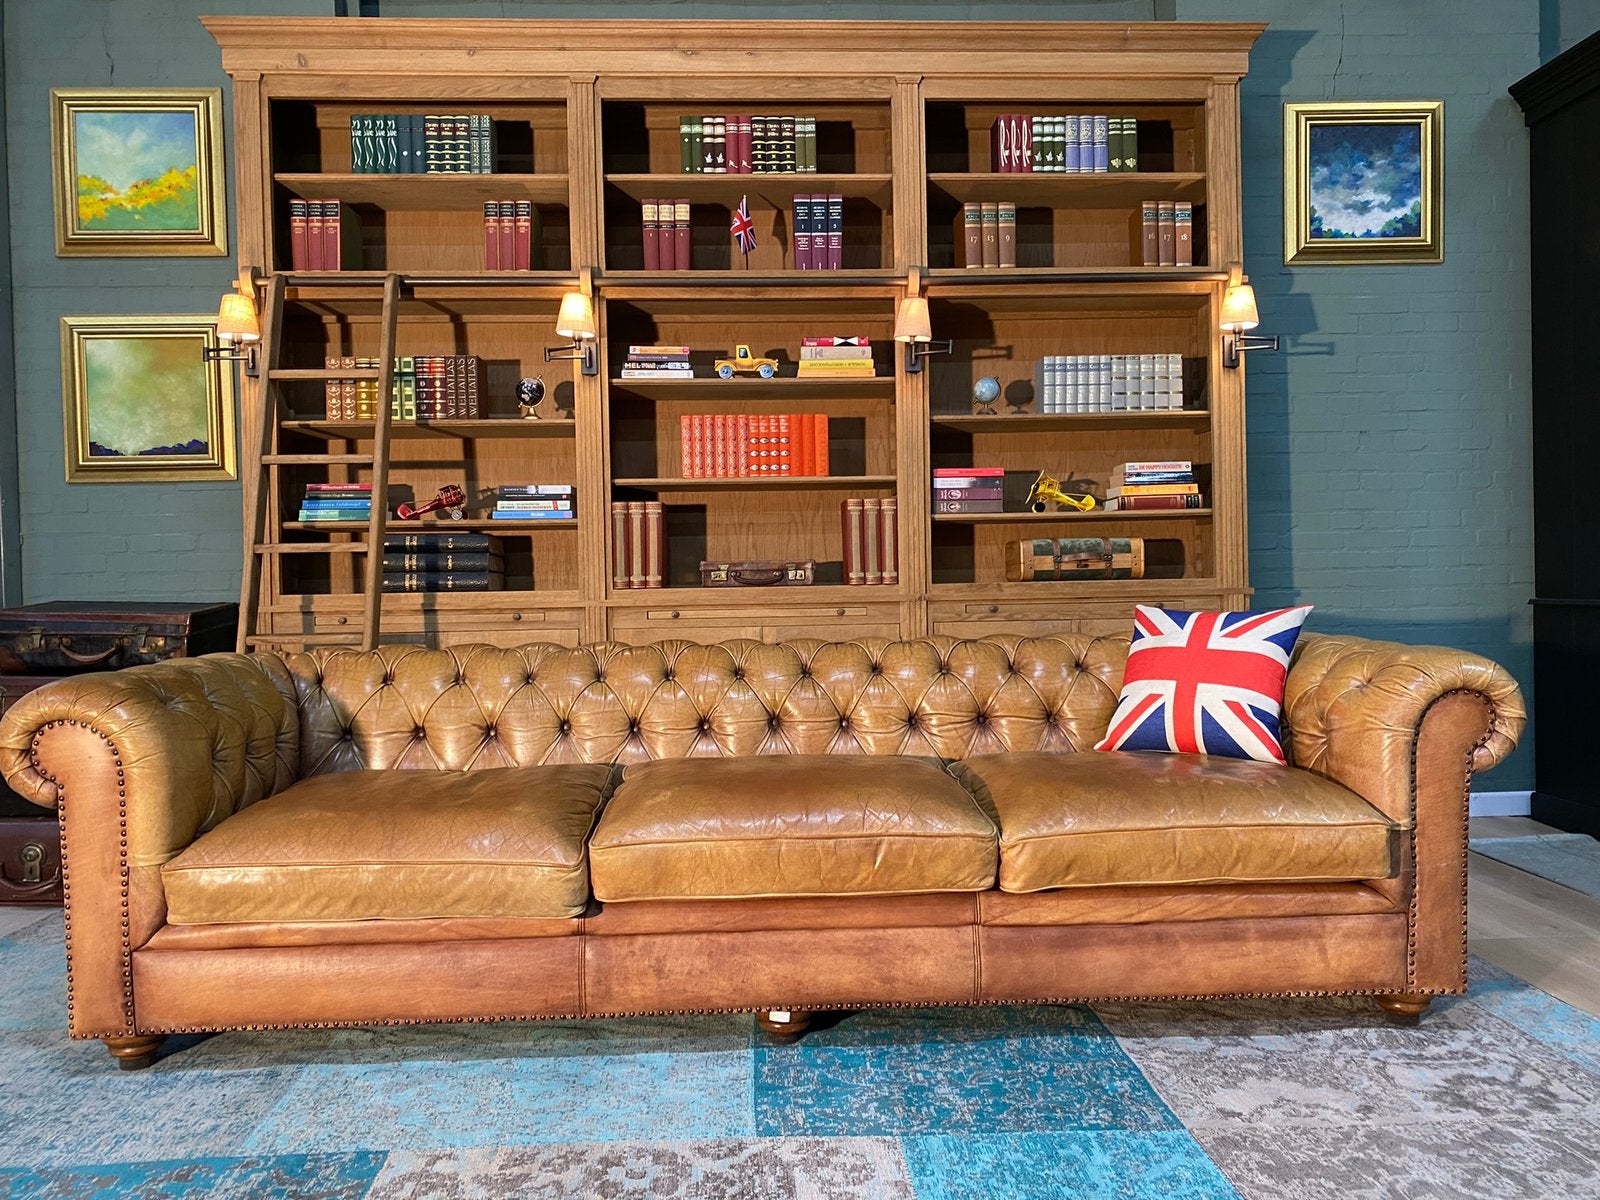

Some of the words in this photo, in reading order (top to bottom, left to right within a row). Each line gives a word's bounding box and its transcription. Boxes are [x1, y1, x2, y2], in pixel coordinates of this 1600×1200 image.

[970, 236, 978, 244] 17
[987, 235, 994, 243] 13
[1164, 234, 1171, 242] 17
[446, 358, 455, 417] WELTATLAS
[458, 358, 466, 416] WELTATLAS
[468, 358, 477, 416] WELTATLAS
